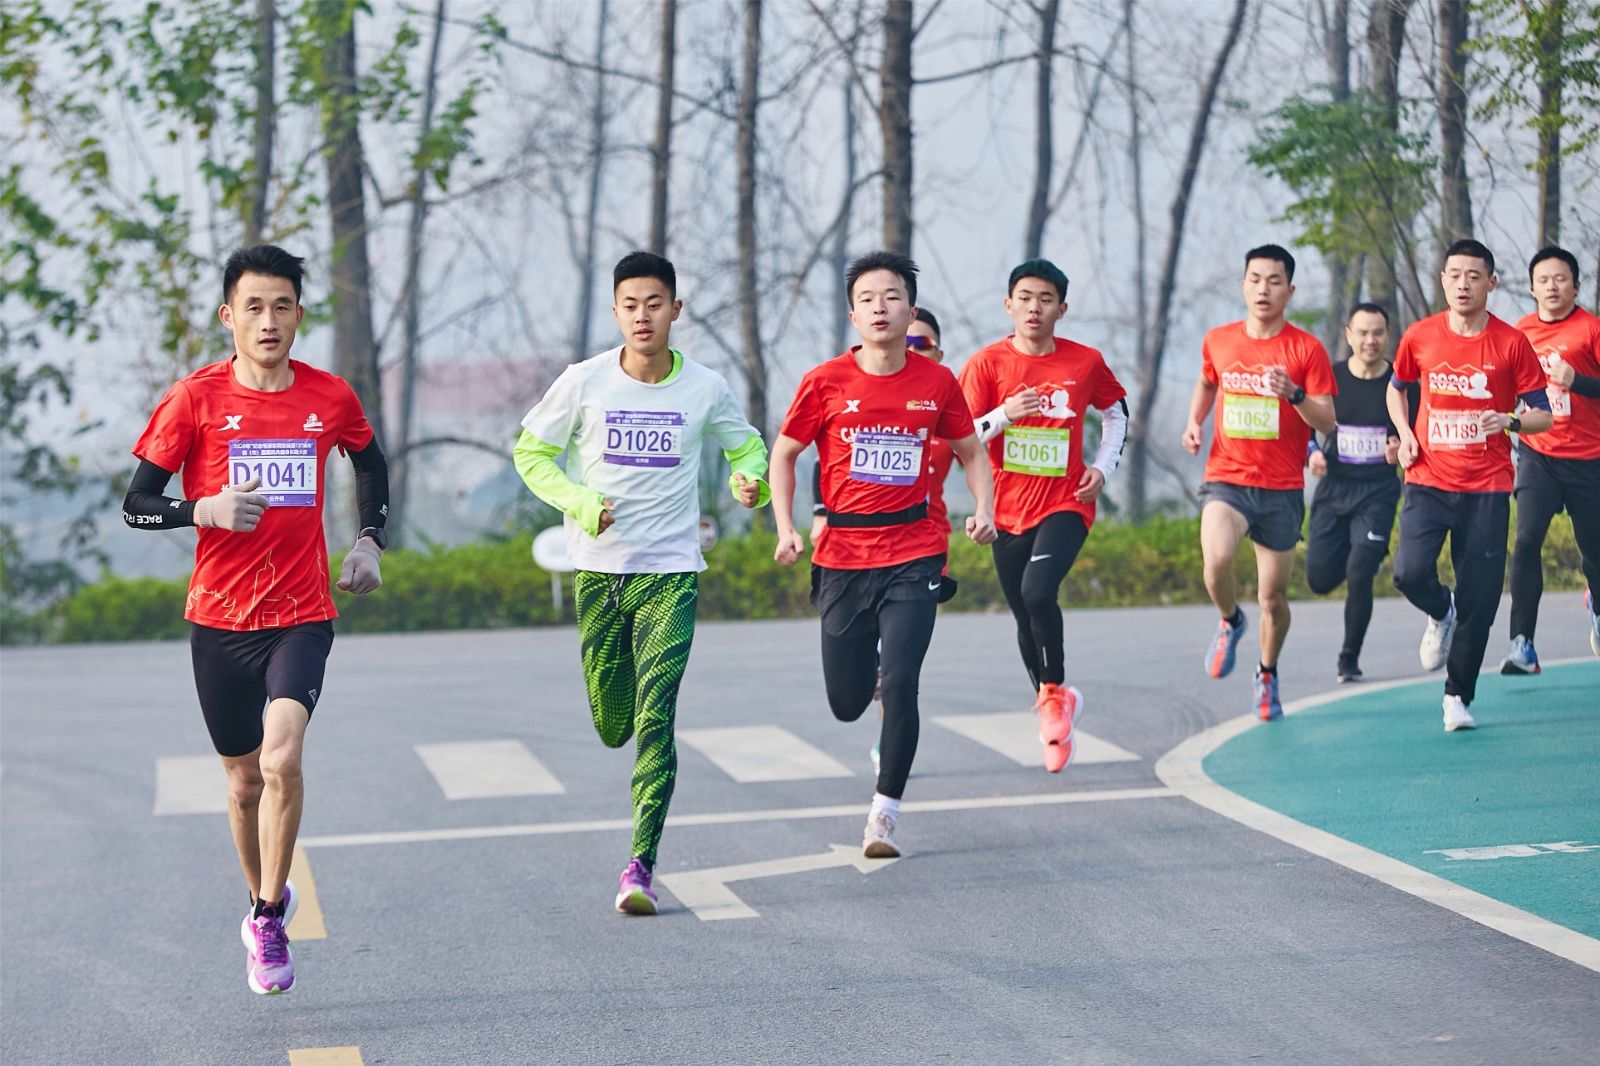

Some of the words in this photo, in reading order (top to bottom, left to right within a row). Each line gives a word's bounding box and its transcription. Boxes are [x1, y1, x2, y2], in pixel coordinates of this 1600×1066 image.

[1427, 372, 1469, 391] 2020
[1226, 409, 1271, 427] C1062
[607, 428, 672, 452] D1026
[1431, 422, 1478, 439] A1189
[854, 448, 912, 471] D1025
[1007, 441, 1058, 462] C1061
[233, 462, 305, 488] D1041
[122, 510, 135, 524] RU
[136, 514, 163, 524] RACE
